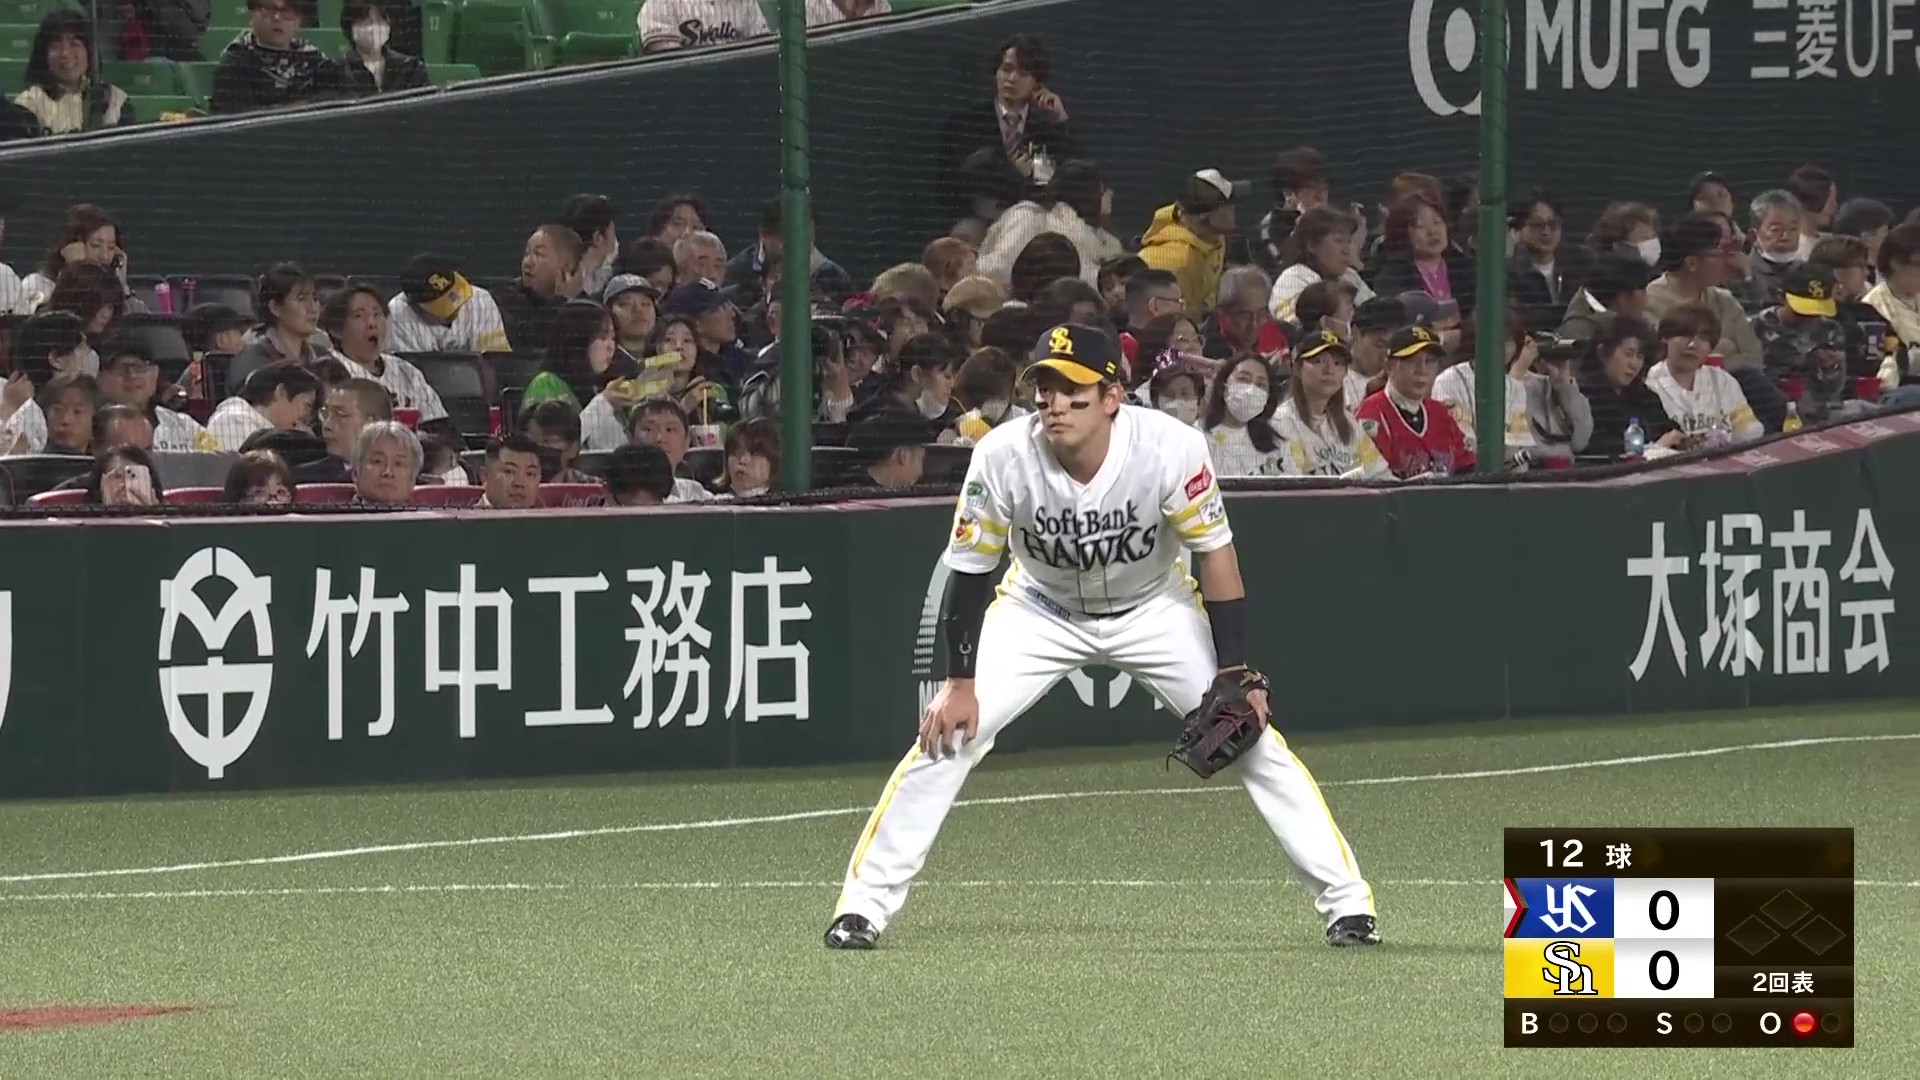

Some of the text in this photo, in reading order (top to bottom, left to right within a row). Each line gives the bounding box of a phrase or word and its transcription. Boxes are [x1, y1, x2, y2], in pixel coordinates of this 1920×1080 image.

[1525, 0, 1711, 90] MUFG
[1019, 523, 1158, 571] HAWKS
[1034, 500, 1138, 537] SoftBank
[1627, 508, 1896, 682] 大塚商会
[306, 556, 813, 741] 竹中工務店
